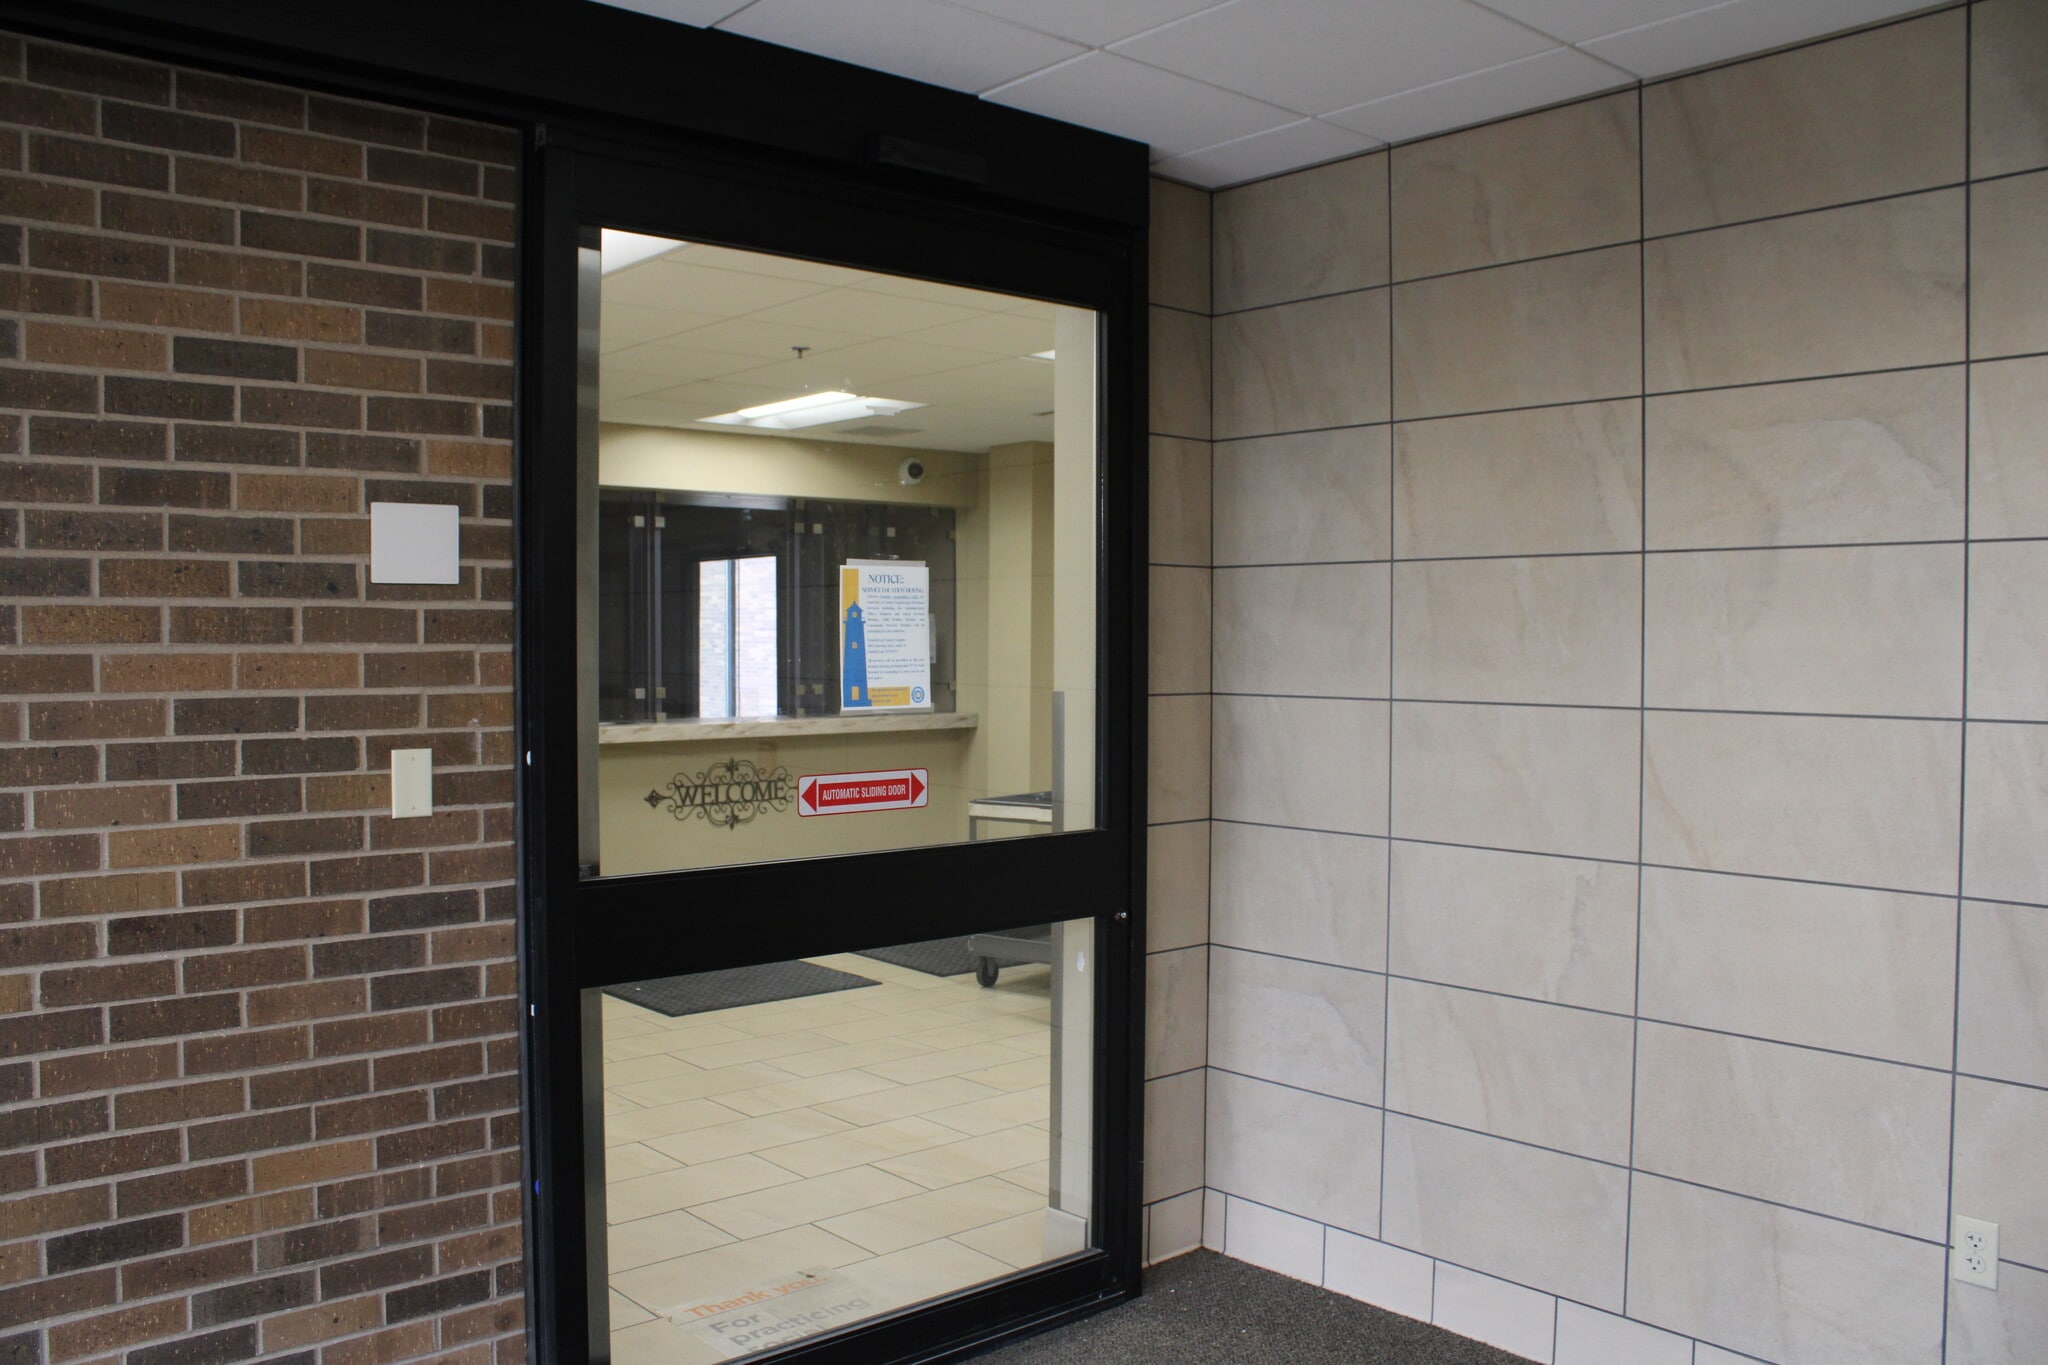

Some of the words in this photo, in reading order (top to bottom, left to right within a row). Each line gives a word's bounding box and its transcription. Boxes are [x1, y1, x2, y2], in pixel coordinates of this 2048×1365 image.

[869, 574, 904, 584] NOTICE:
[676, 778, 786, 807] WELCOME
[822, 786, 860, 801] AUTOMATIC
[861, 784, 887, 799] SLIDING
[887, 783, 906, 797] DOOR
[684, 1290, 768, 1317] Thank
[709, 1312, 760, 1334] For
[730, 1297, 870, 1346] practicing
